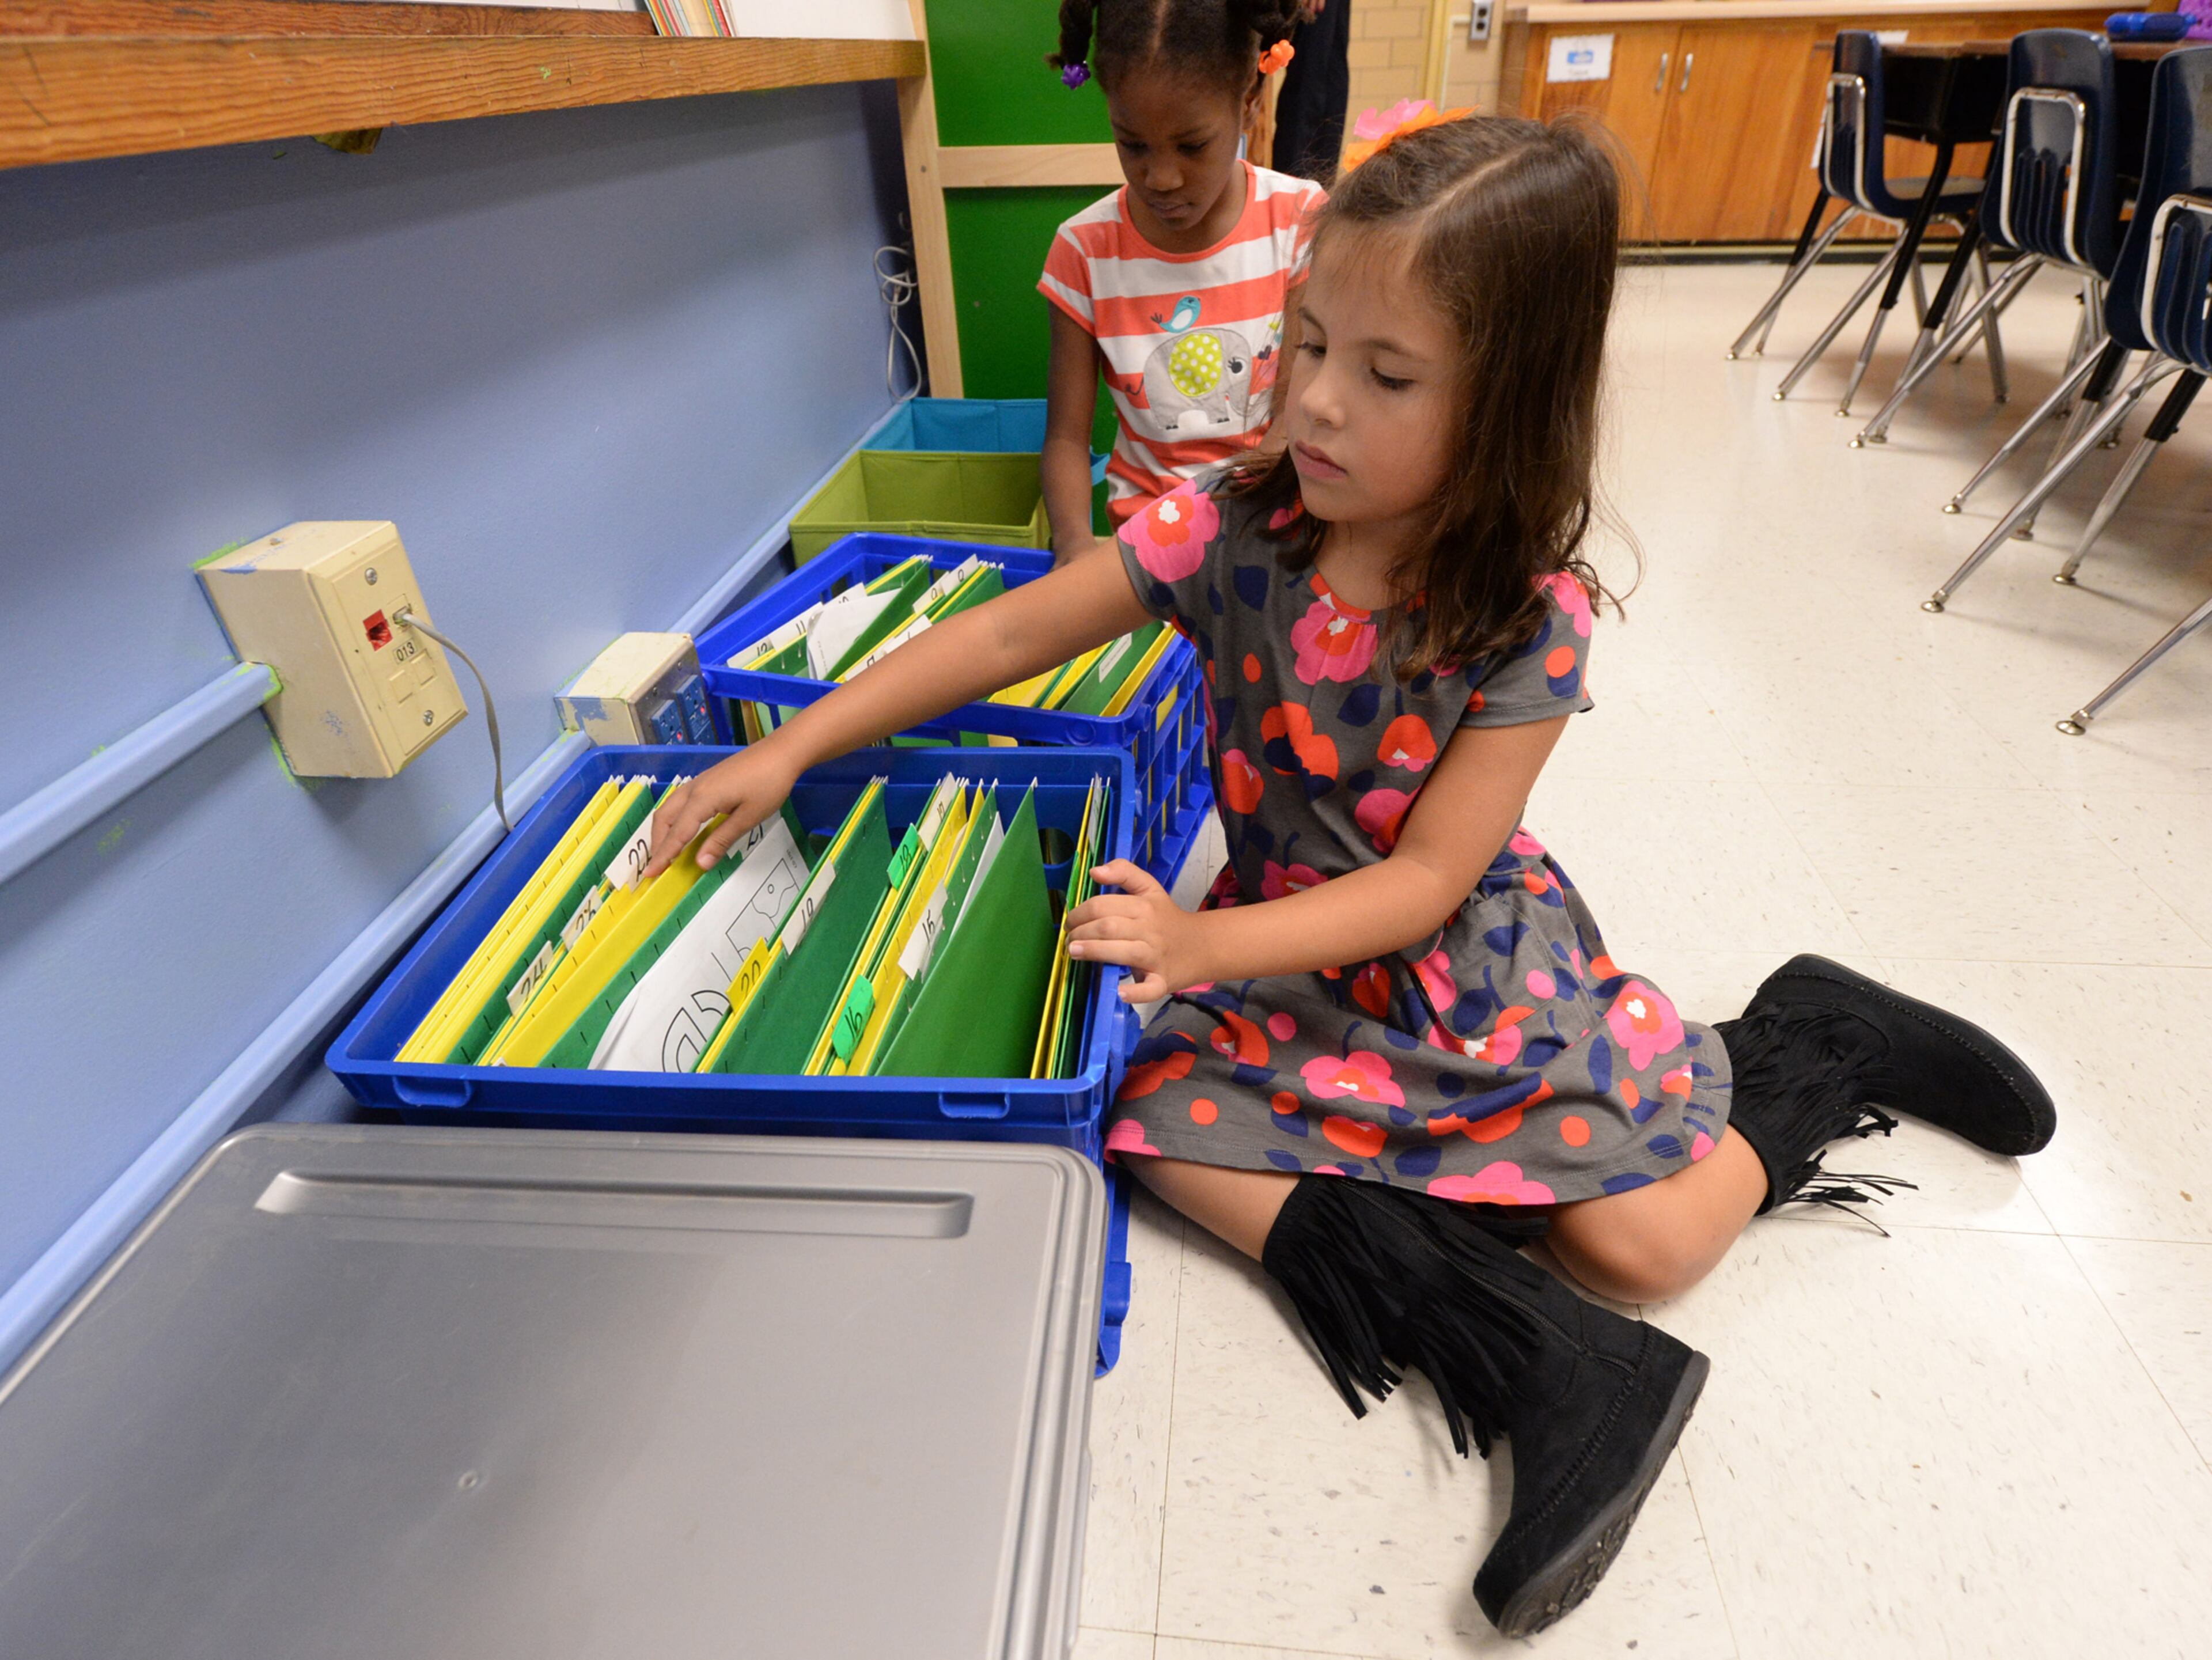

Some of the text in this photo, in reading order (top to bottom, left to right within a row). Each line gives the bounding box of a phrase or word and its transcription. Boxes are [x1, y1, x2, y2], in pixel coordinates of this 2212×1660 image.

[396, 641, 415, 662] 013
[628, 839, 652, 882] 22
[520, 957, 547, 1003] 24
[844, 1006, 863, 1043] 16
